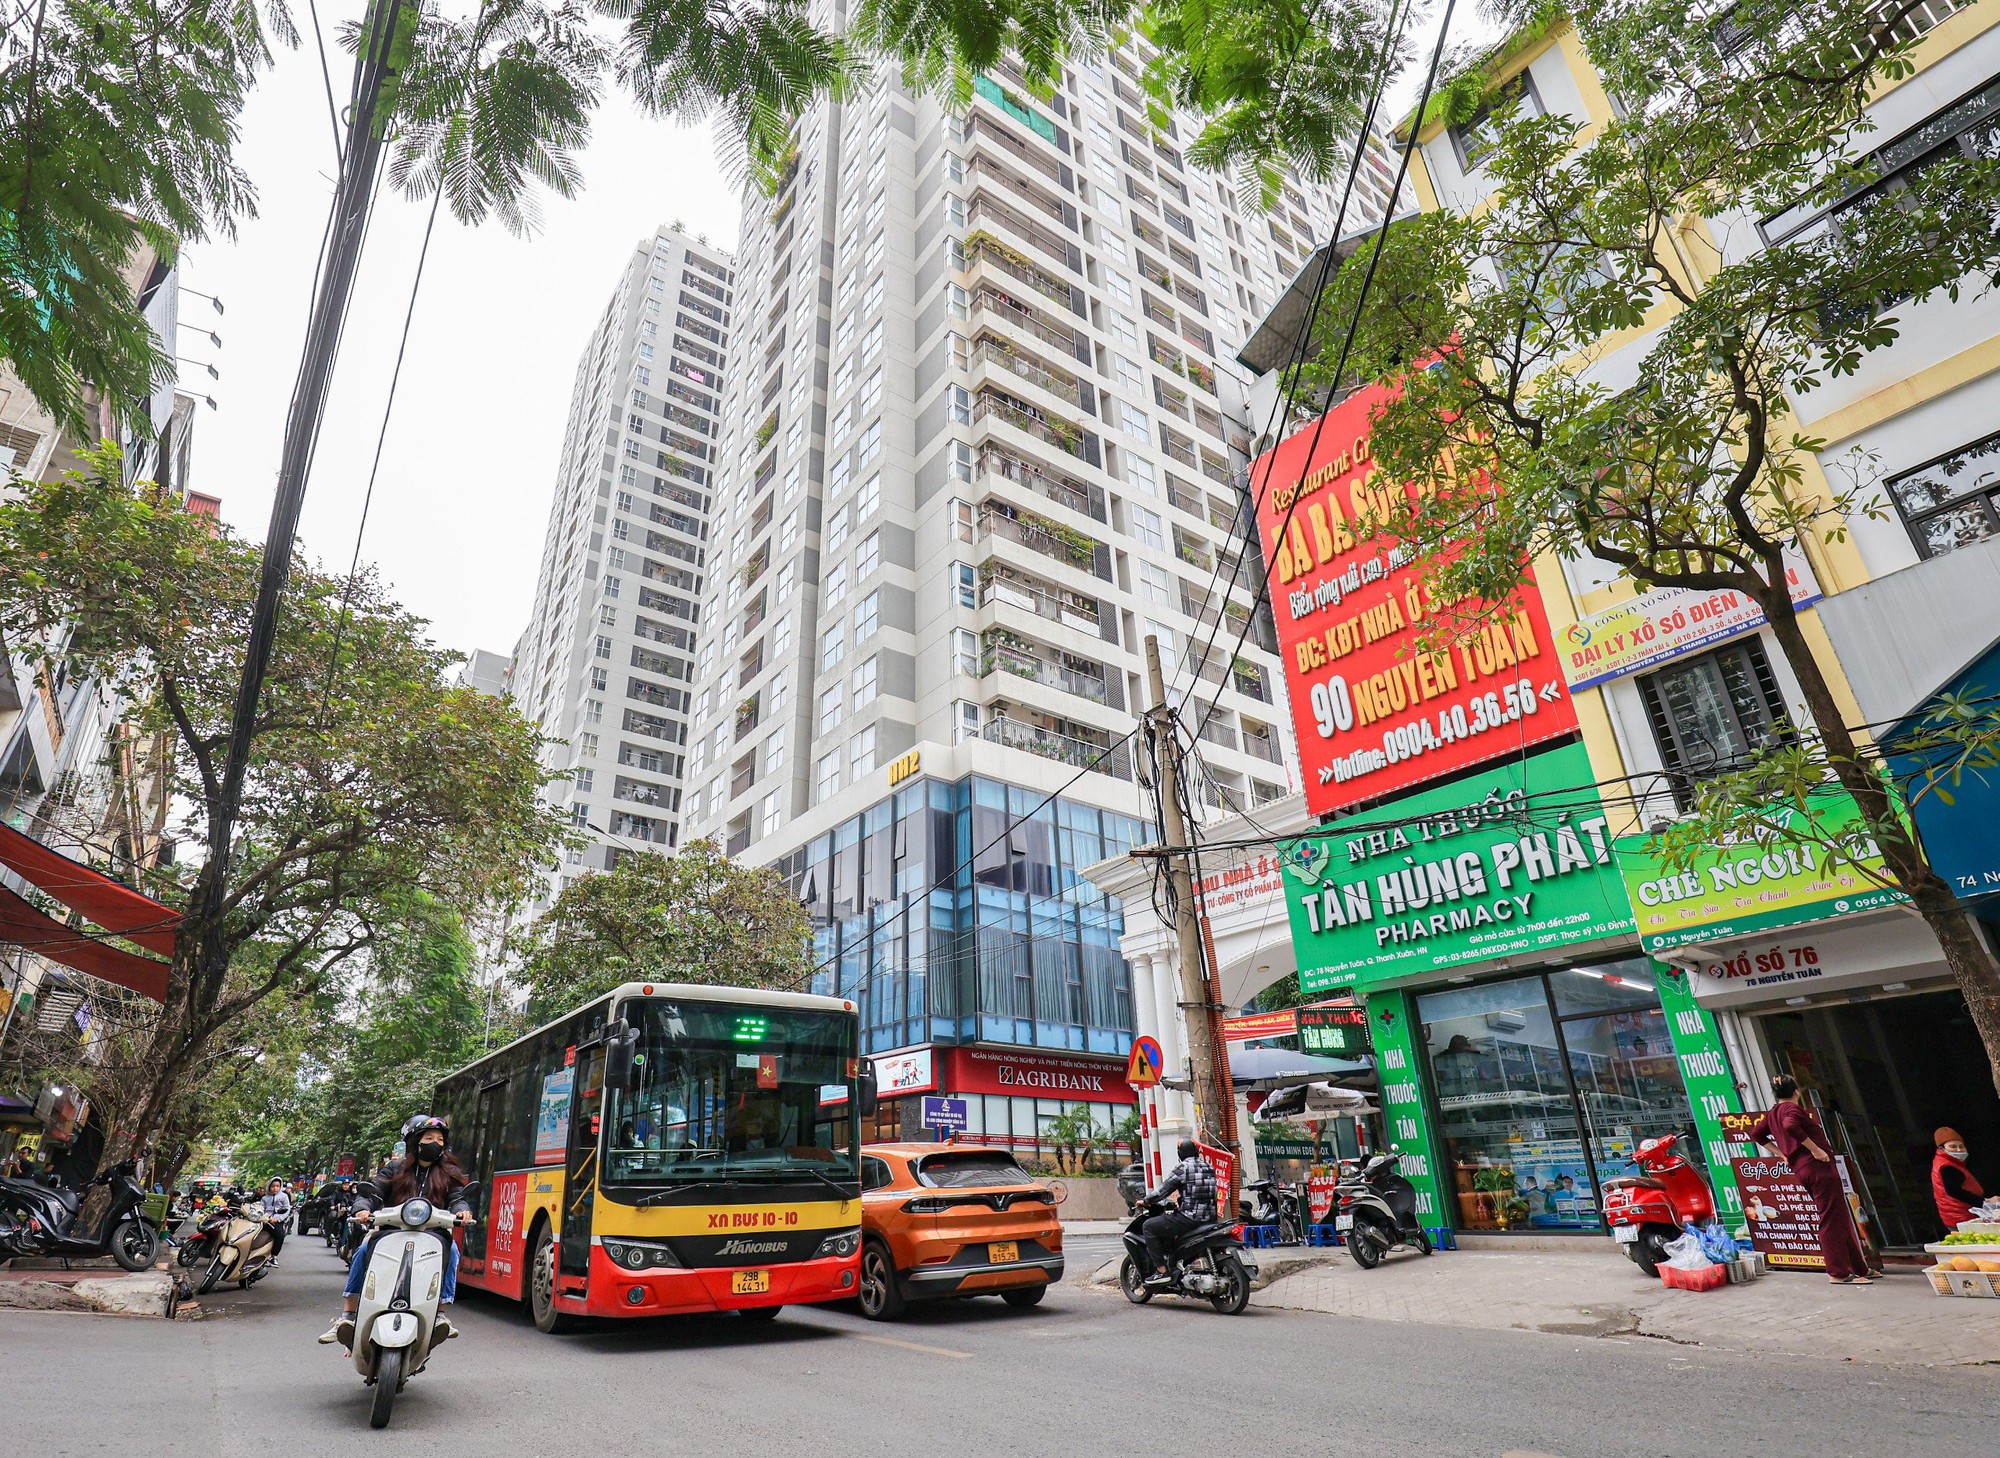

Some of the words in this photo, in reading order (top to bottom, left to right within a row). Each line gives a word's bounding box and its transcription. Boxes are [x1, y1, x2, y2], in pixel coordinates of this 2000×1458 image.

[1271, 449, 1351, 515] Restaurant
[1360, 592, 1407, 644] NHÀ
[1404, 577, 1423, 623] Ở
[1595, 611, 1623, 628] CÔNG
[1624, 605, 1639, 616] TY
[1571, 644, 1603, 668] ĐẠI
[1604, 632, 1625, 656] LÝ
[1629, 616, 1656, 646] XỔ
[1659, 605, 1687, 635] SỐ
[1689, 591, 1739, 624] ĐIỆN
[1310, 675, 1355, 739] 90
[1332, 746, 1388, 785] Hotline:
[1383, 677, 1539, 765] 0904.40.36.56
[1222, 862, 1254, 888] NHÀ
[1257, 855, 1269, 877] Ở
[1301, 880, 1374, 934] TÂN
[1376, 851, 1489, 917] HÙNG
[1489, 812, 1614, 888] PHÁT
[1707, 845, 1816, 892] NGON
[1955, 874, 1978, 889] 74
[1855, 895, 1887, 908] 0964
[1375, 893, 1535, 948] PHARMACY
[1527, 921, 1546, 933] 7h00
[1547, 917, 1564, 929] đến
[1565, 913, 1591, 925] 22h00
[1375, 952, 1395, 963] Thanh
[1417, 946, 1428, 955] HN
[1721, 950, 1752, 979] XỔ
[1755, 945, 1786, 974] SỐ
[1788, 946, 1819, 967] 76
[1326, 1010, 1365, 1025] THUỐC
[1675, 1005, 1706, 1036] NHÀ
[1302, 1025, 1320, 1049] TÂN
[1320, 1024, 1346, 1049] HÙNG
[1384, 1044, 1407, 1070] NHÀ
[1681, 1043, 1725, 1078] THUỐC
[1015, 1070, 1104, 1092] AGRIBANK
[1384, 1076, 1418, 1105] THUỐC
[1701, 1090, 1729, 1121] TÂN
[1396, 1114, 1418, 1140] TÂN
[1733, 1131, 1751, 1142] TRÀ
[500, 1182, 518, 1204] YOUR
[1769, 1184, 1781, 1192] CÀ
[1781, 1184, 1796, 1192] PHÊ
[1776, 1193, 1787, 1202] CÀ
[1787, 1193, 1802, 1202] PHÊ
[497, 1204, 515, 1232] ADS
[1779, 1203, 1790, 1211] CÀ
[1790, 1203, 1805, 1212] PHÊ
[1795, 1213, 1810, 1222] BẠC
[733, 1212, 759, 1227] BUS
[763, 1212, 776, 1226] 10
[785, 1211, 798, 1225] 10
[1758, 1222, 1772, 1230] TRÀ
[1772, 1222, 1797, 1231] CHANH
[495, 1231, 513, 1252] HERE
[1754, 1231, 1769, 1240] TRÀ
[1799, 1231, 1815, 1240] TRÀ
[1773, 1241, 1788, 1250] TRÀ
[1788, 1242, 1804, 1250] ĐÀO
[1804, 1243, 1821, 1251] CAM
[997, 1244, 1010, 1253] 29H
[737, 1281, 765, 1293] 144.31
[742, 1271, 759, 1282] 29B
